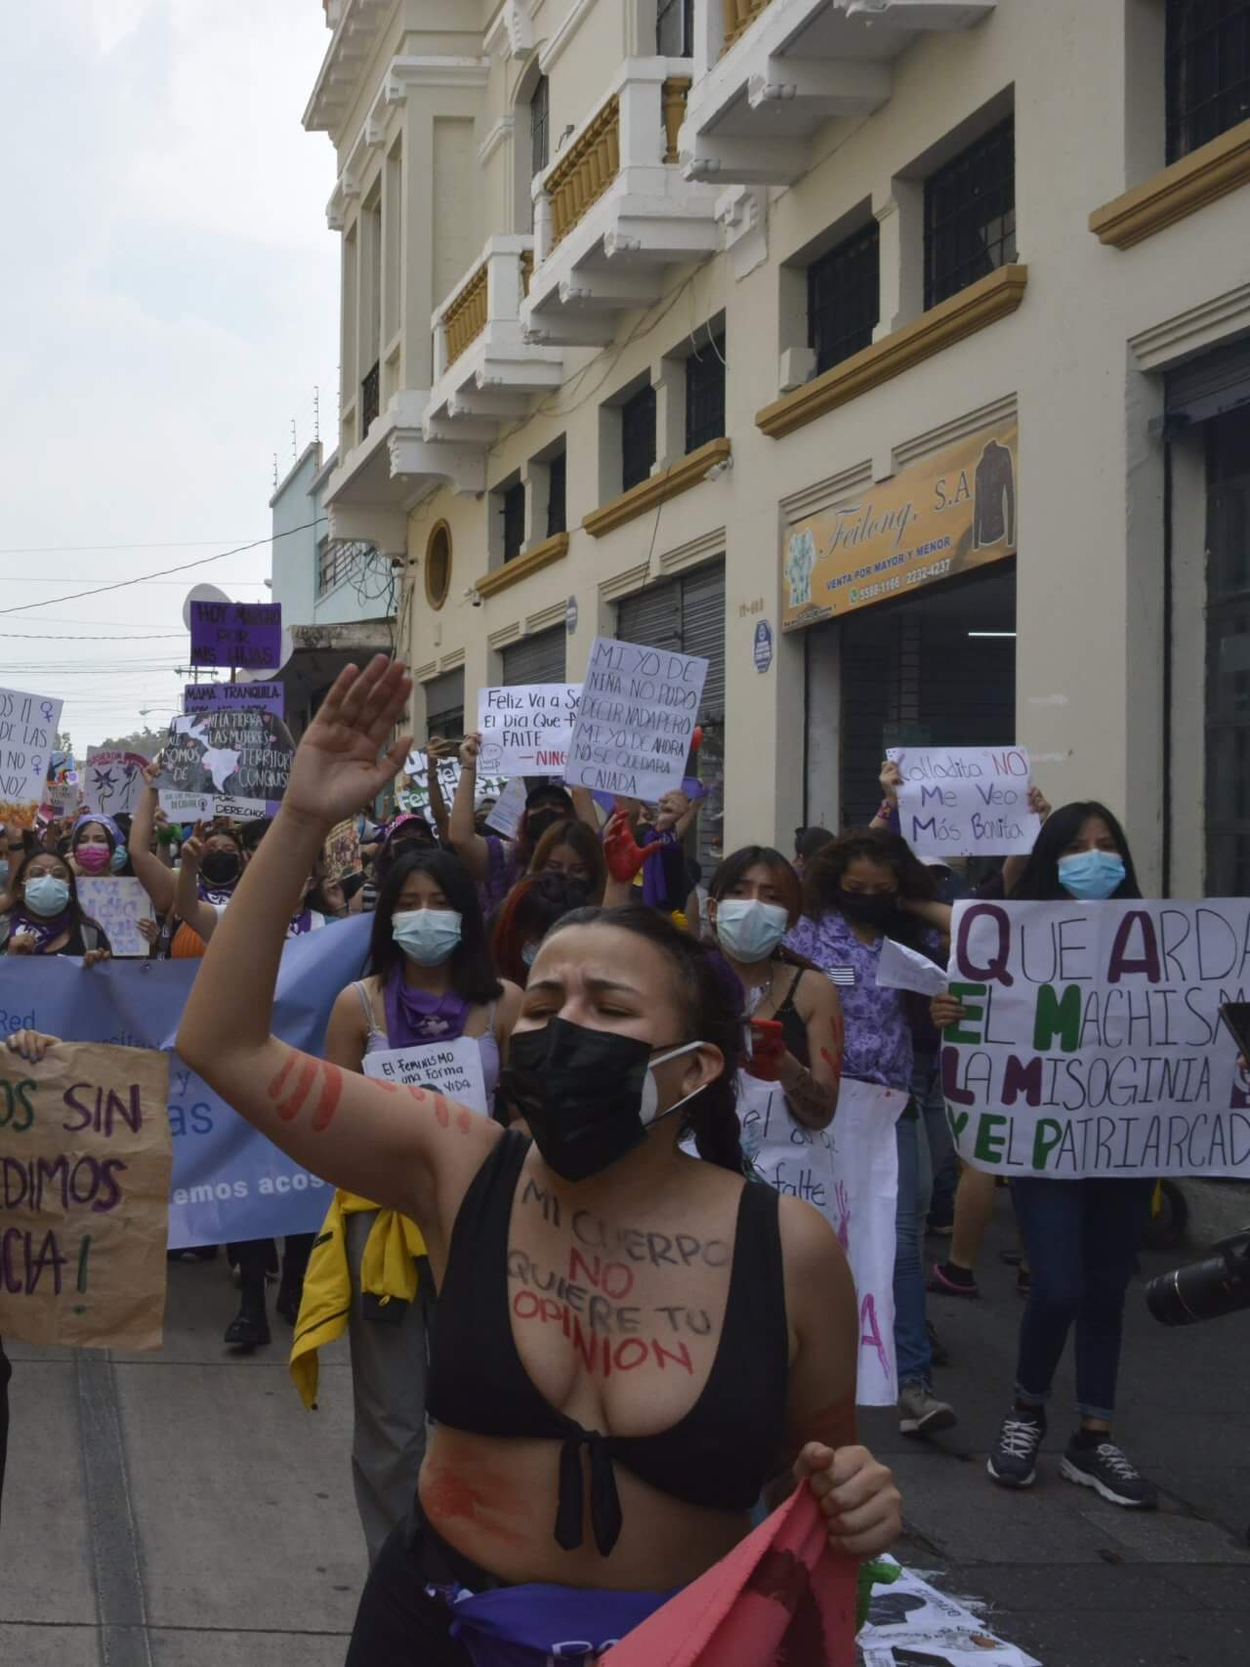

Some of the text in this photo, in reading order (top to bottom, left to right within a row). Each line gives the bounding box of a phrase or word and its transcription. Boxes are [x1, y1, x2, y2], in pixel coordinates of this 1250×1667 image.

[827, 536, 950, 591] VENTA POR MAYOR Y MENOR
[592, 644, 698, 682] MI YO DE
[488, 690, 524, 709] Feliz
[529, 693, 545, 708] Va
[550, 697, 559, 707] a
[588, 672, 697, 710] NIÑA NO PUDO
[484, 715, 496, 728] El
[533, 712, 561, 727] Que
[581, 696, 624, 724] DECIR
[0, 721, 17, 742] DE
[23, 726, 48, 748] LAS
[576, 722, 684, 758] MI YO DE AHORA
[7, 751, 26, 770] NO
[162, 748, 201, 763] SOMOS
[574, 744, 591, 764] NO
[0, 774, 27, 798] VOZ
[173, 767, 188, 781] DE
[921, 783, 1018, 808] Me Veo
[215, 805, 265, 820] DERECHOS
[913, 812, 1024, 842] Más Bonita
[957, 903, 1093, 986] QUE
[943, 982, 1015, 1045] EL
[177, 1071, 190, 1097] y
[382, 1063, 394, 1076] El
[942, 1046, 1211, 1108] LA MISOGINIA
[62, 1083, 143, 1137] SIN
[974, 1113, 1024, 1164] EL
[522, 1179, 730, 1268] MI CUERPO
[568, 1247, 634, 1301] NO
[507, 1252, 711, 1335] QUIERE TU
[513, 1290, 695, 1378] OPINION
